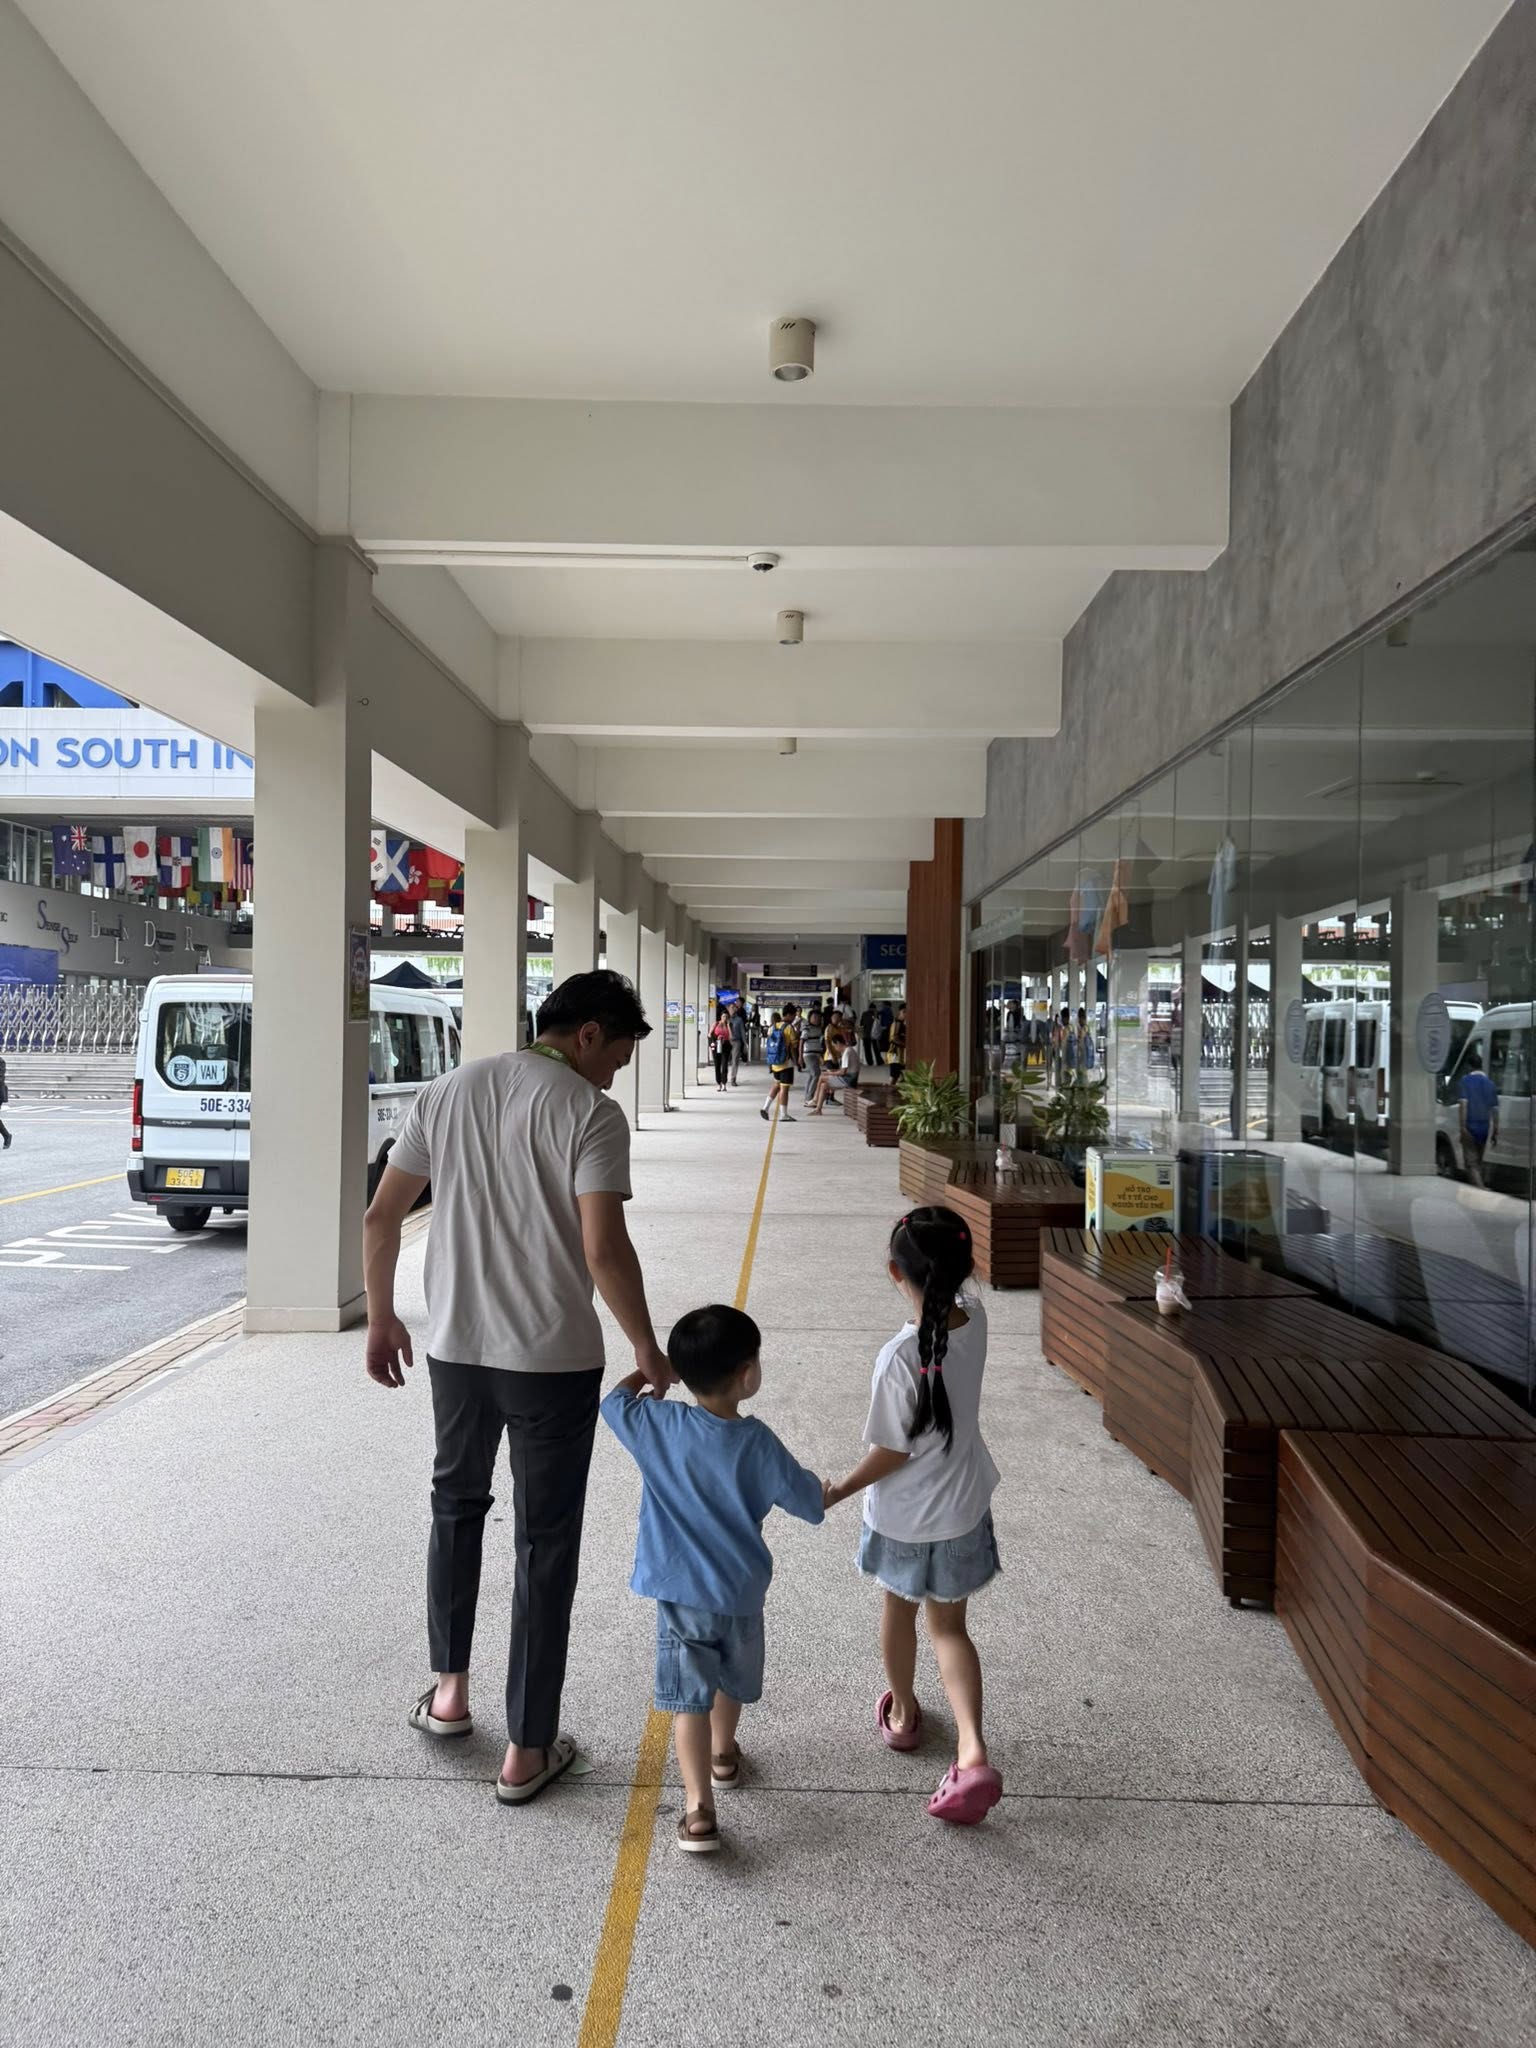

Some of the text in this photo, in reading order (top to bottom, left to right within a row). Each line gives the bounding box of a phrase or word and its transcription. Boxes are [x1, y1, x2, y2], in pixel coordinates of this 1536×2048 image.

[0, 737, 39, 767] N
[56, 737, 198, 769] SOUTH
[880, 943, 905, 957] SEC
[200, 1065, 217, 1080] VAN
[200, 1098, 251, 1112] 50E-334
